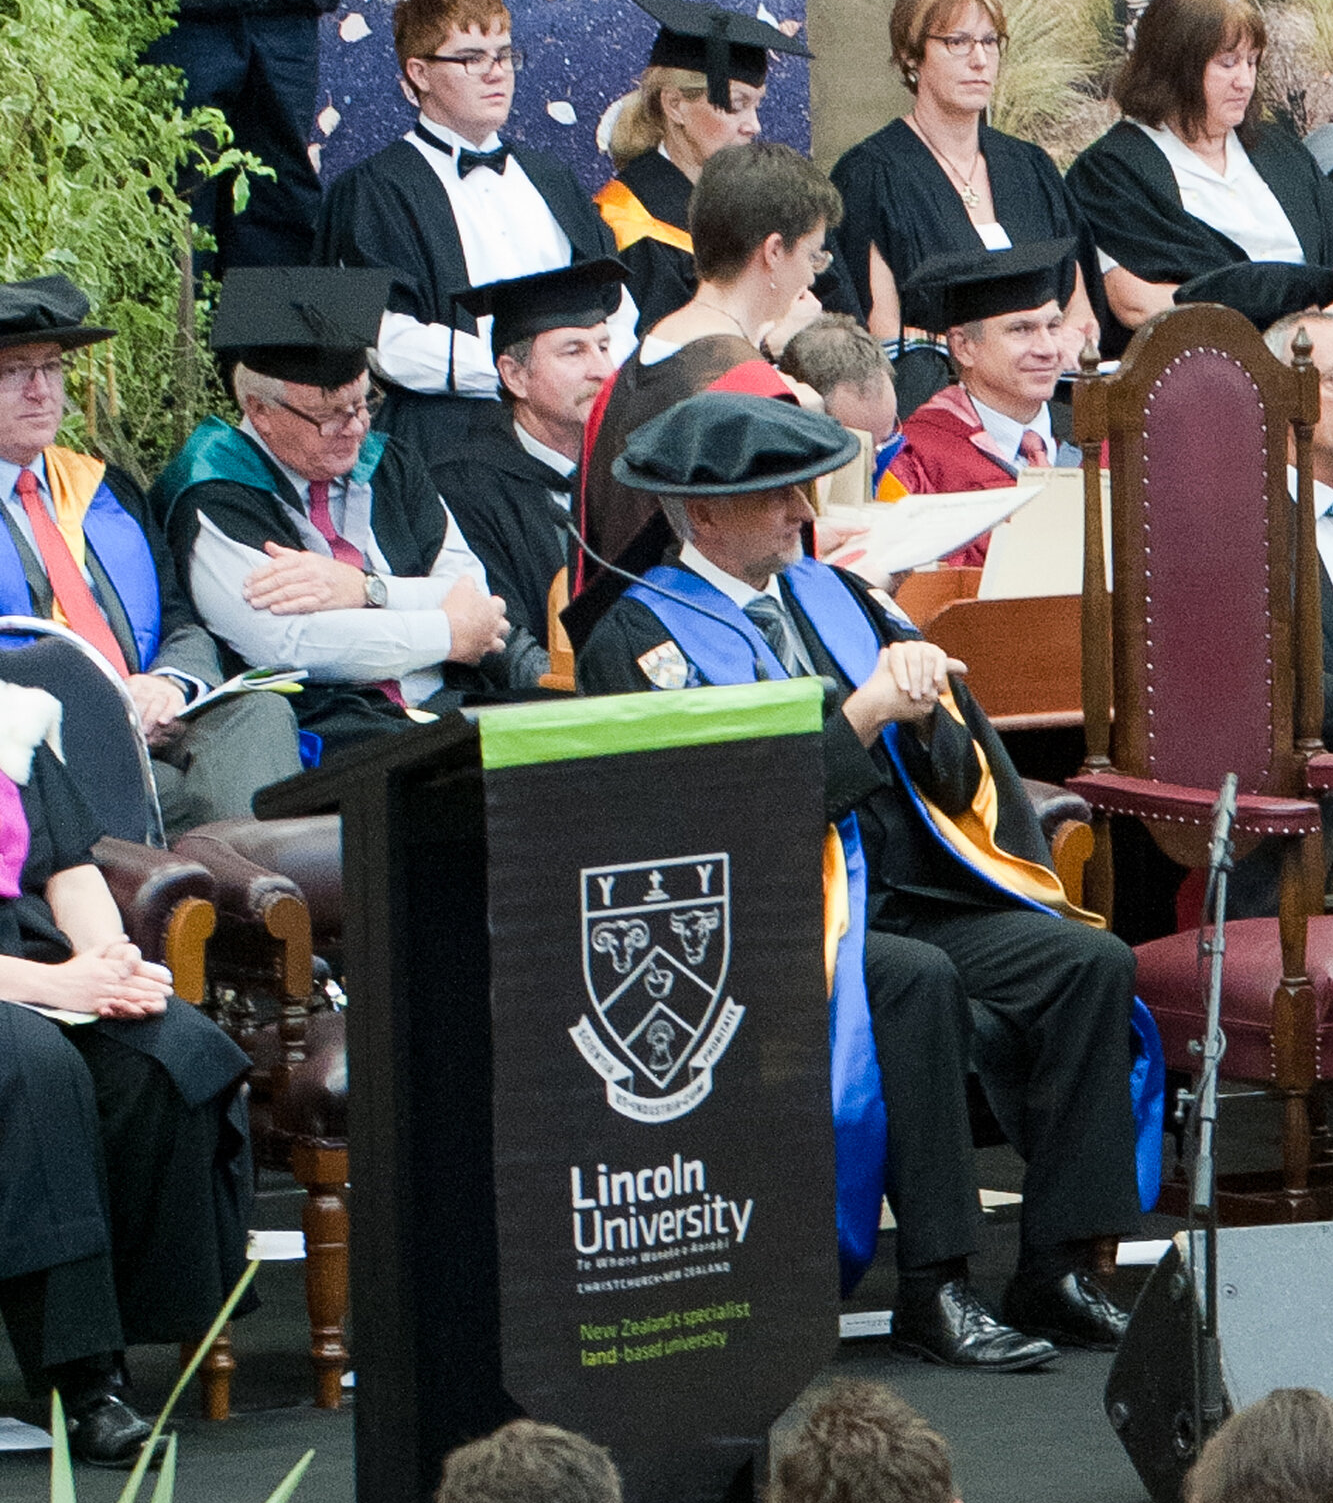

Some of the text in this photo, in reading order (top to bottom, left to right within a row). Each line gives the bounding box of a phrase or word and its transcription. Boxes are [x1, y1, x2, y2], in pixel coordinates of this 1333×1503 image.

[570, 1153, 706, 1209] Lincoln
[572, 1193, 753, 1255] University
[580, 1301, 751, 1341] New Zealand's specialist
[664, 1330, 729, 1355] university
